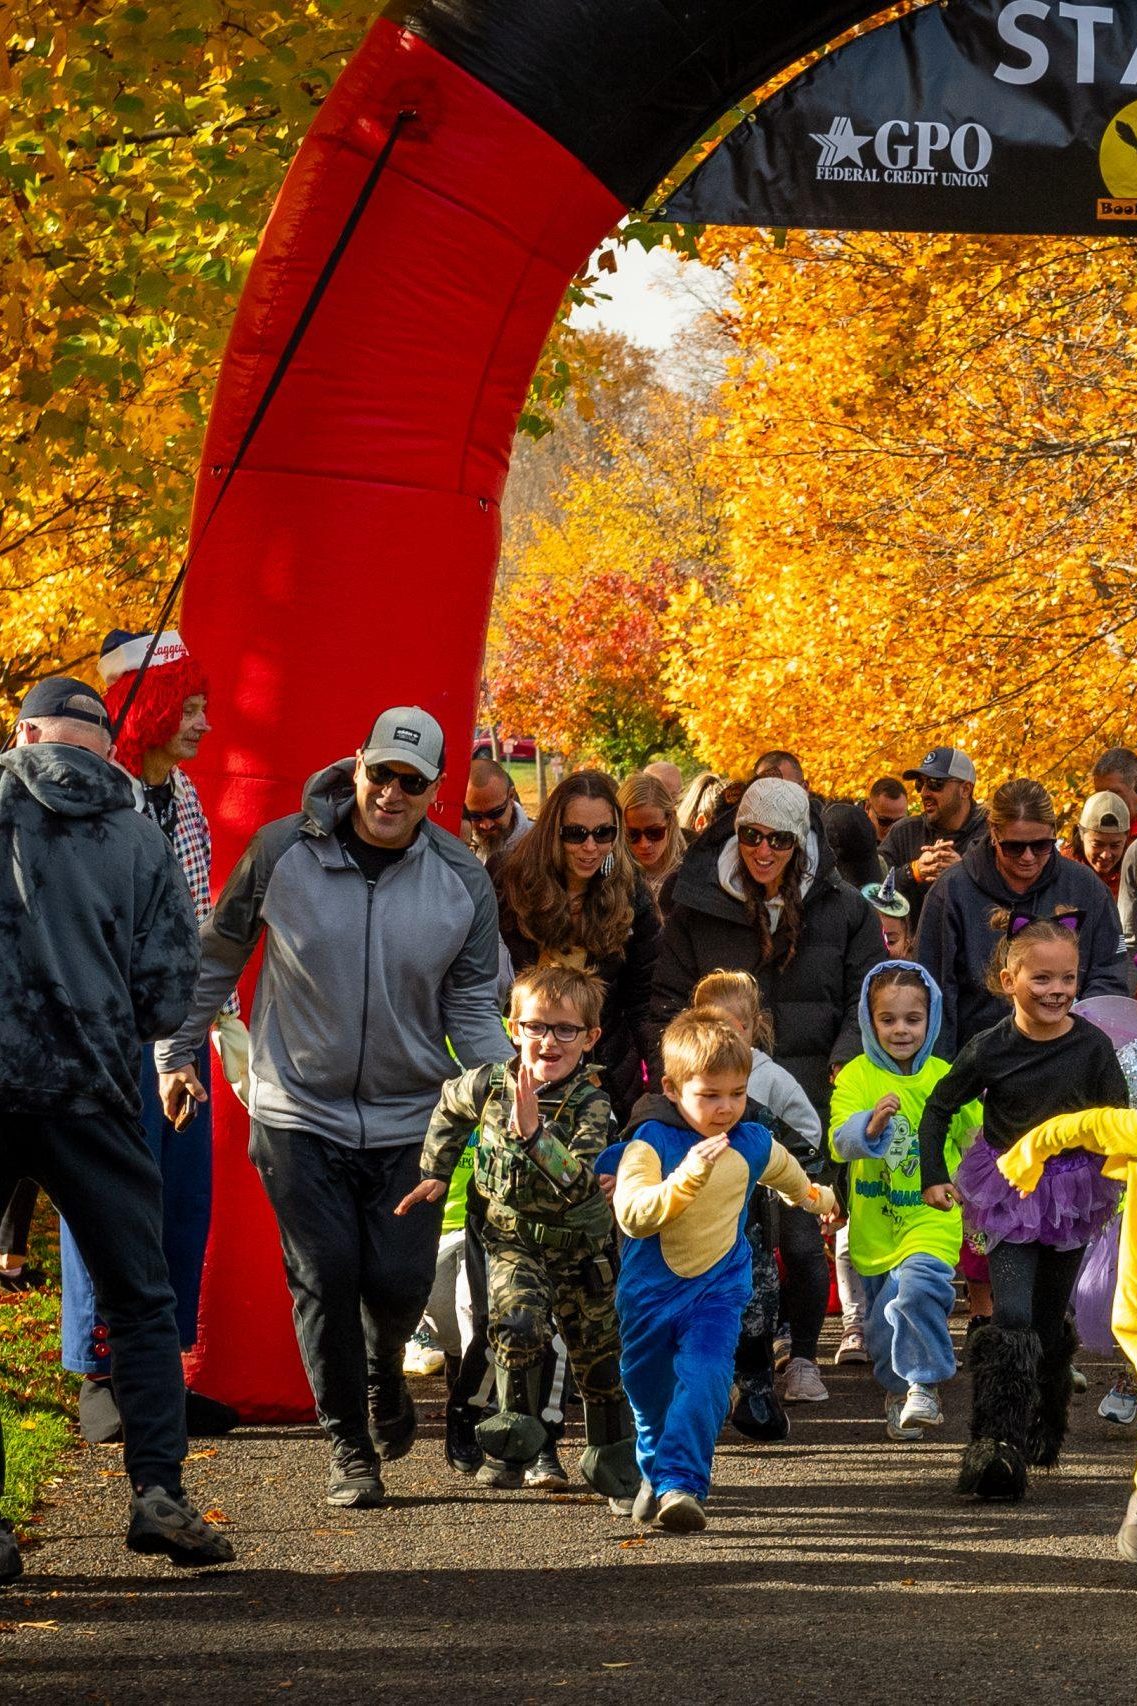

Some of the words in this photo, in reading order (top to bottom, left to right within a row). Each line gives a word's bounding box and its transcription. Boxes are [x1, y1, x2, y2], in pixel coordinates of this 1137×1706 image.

[874, 120, 993, 173] GPO
[815, 167, 880, 182] FEDERAL
[883, 170, 938, 186] CREDIT
[941, 173, 989, 188] UNION
